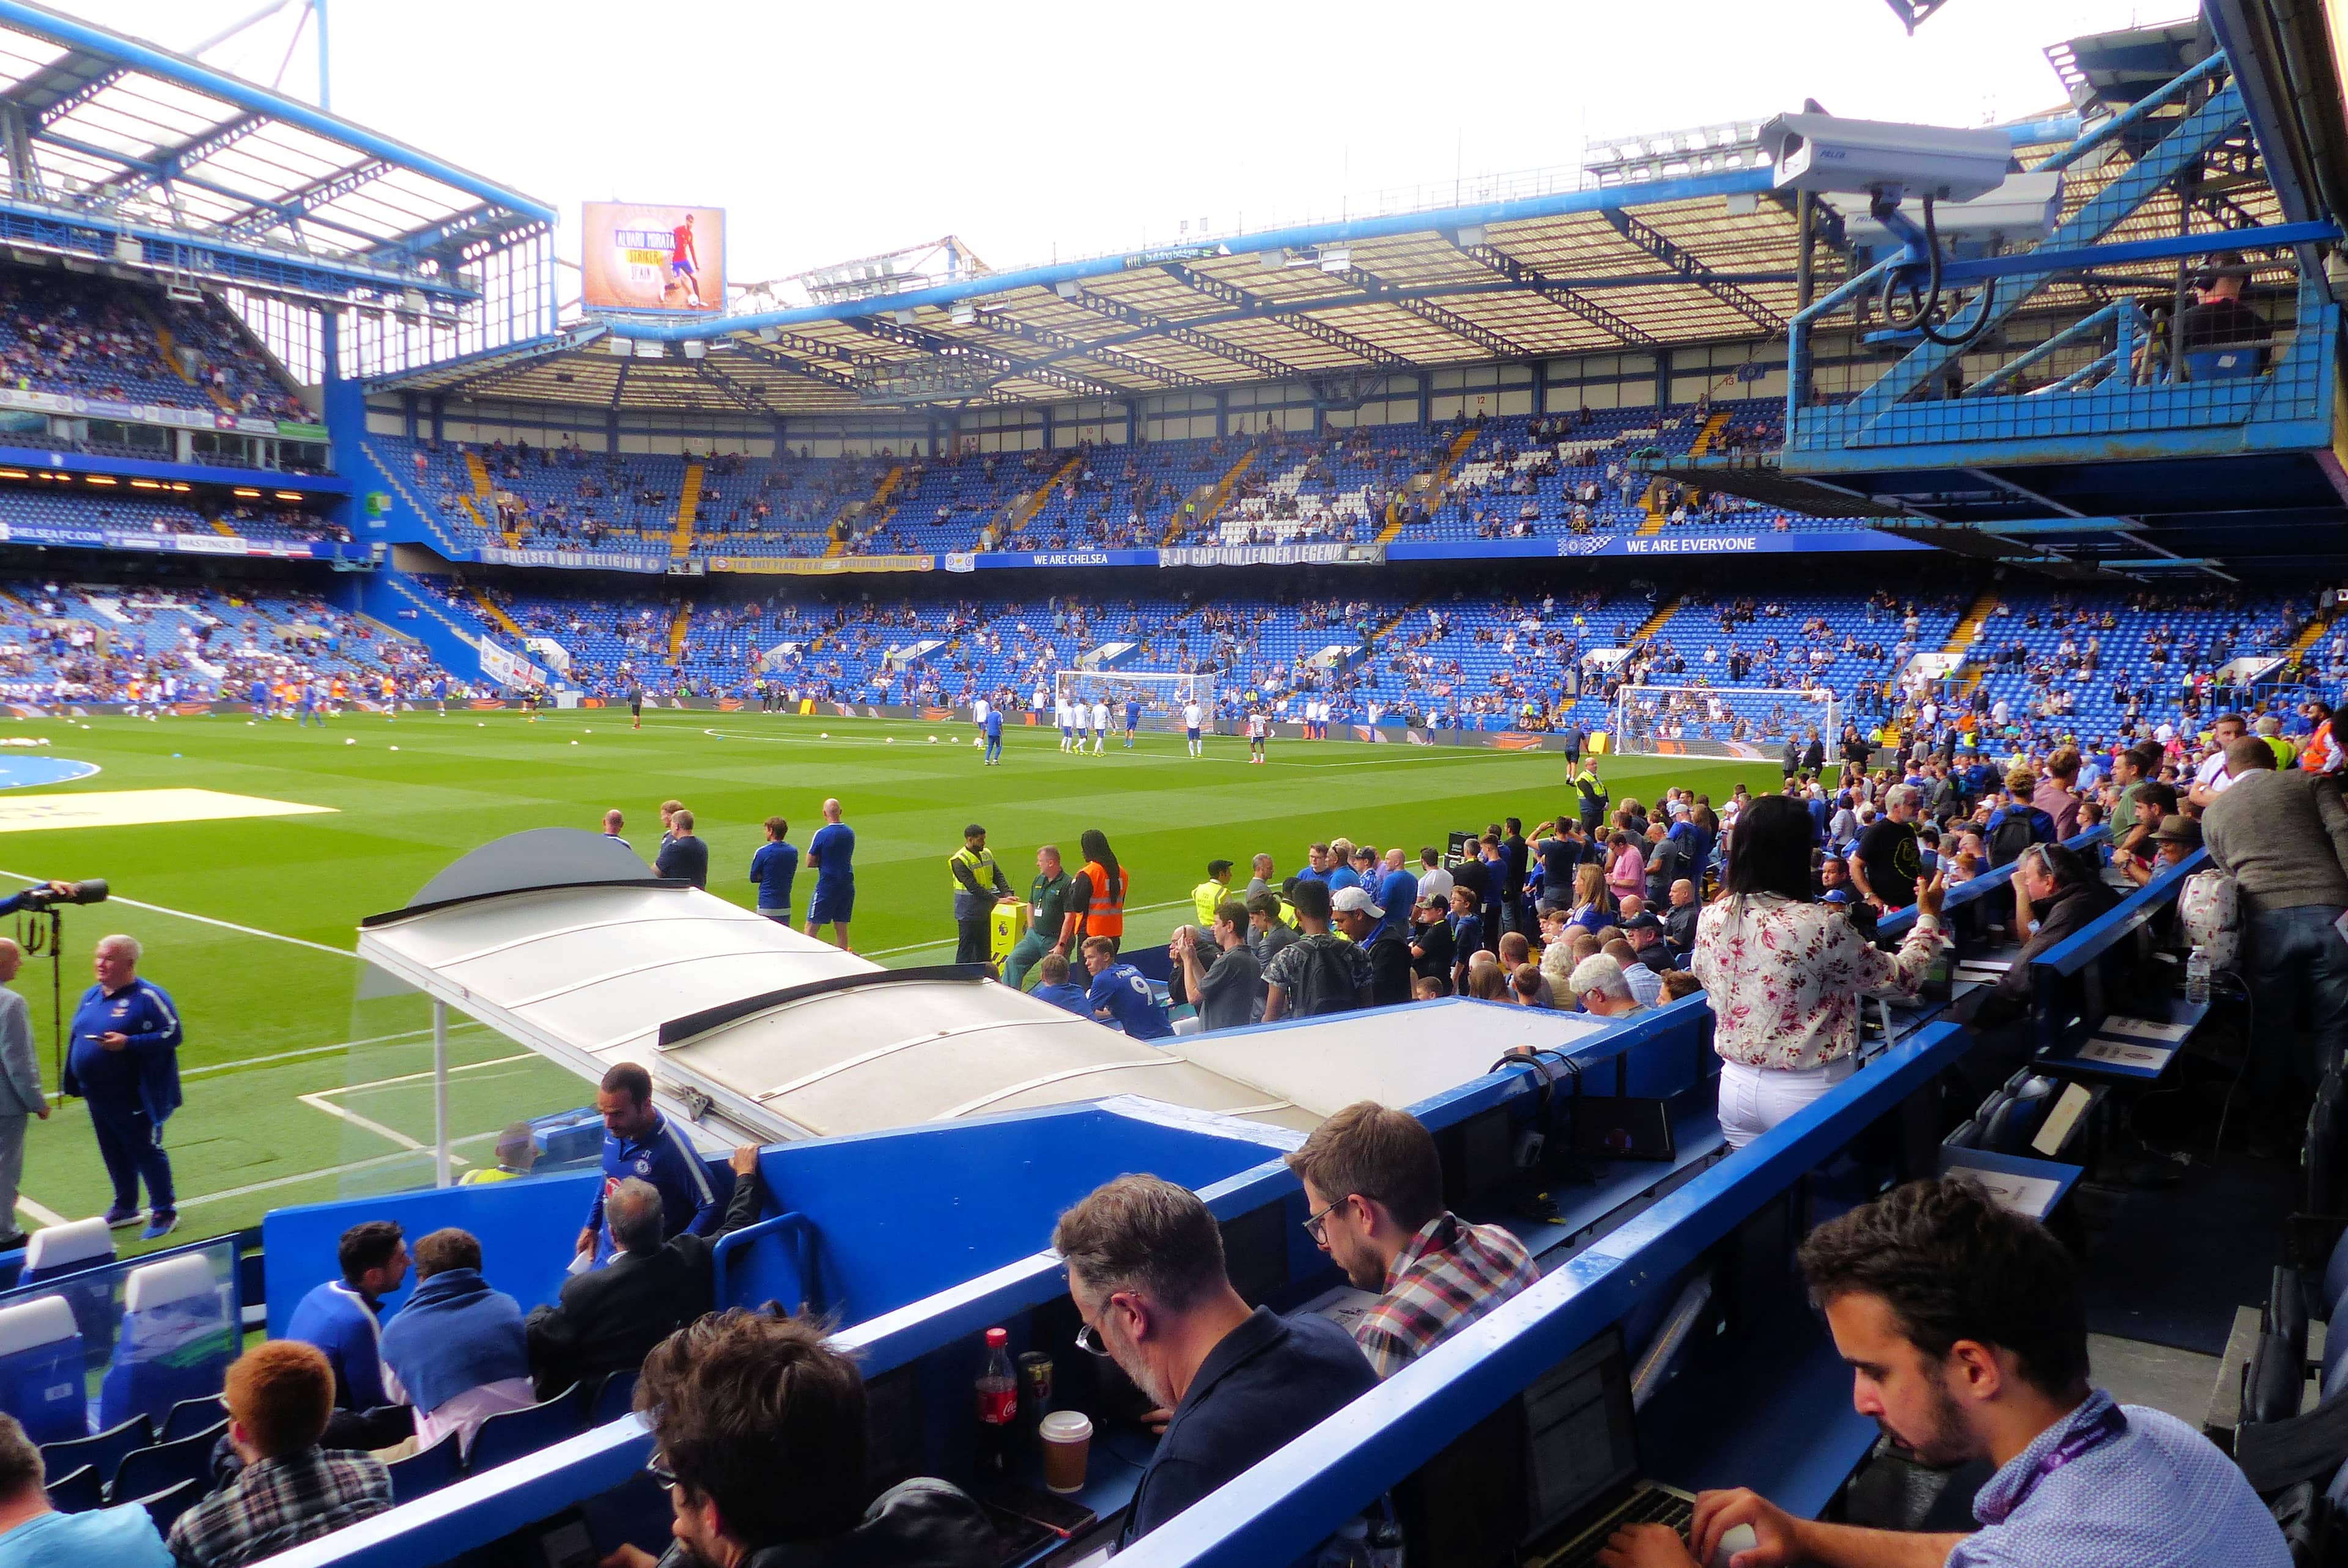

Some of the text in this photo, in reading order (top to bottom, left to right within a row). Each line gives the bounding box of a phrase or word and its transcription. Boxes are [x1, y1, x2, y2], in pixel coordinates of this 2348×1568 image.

[618, 231, 676, 250] ALVARO MORATA
[629, 249, 660, 265] STRIKER
[1627, 537, 1756, 553] WE ARE EVERYONE
[502, 551, 642, 570] CHELSEA OUR RELIGION
[733, 561, 748, 569] THE
[751, 560, 770, 569] ONLY
[773, 561, 800, 570] PLACE
[803, 562, 812, 570] TO
[884, 558, 917, 568] SATURDAY
[1033, 553, 1108, 565] WE ARE CHELSEA
[1174, 550, 1187, 564] JT
[1131, 976, 1153, 1006] 9
[641, 1150, 652, 1160] JT
